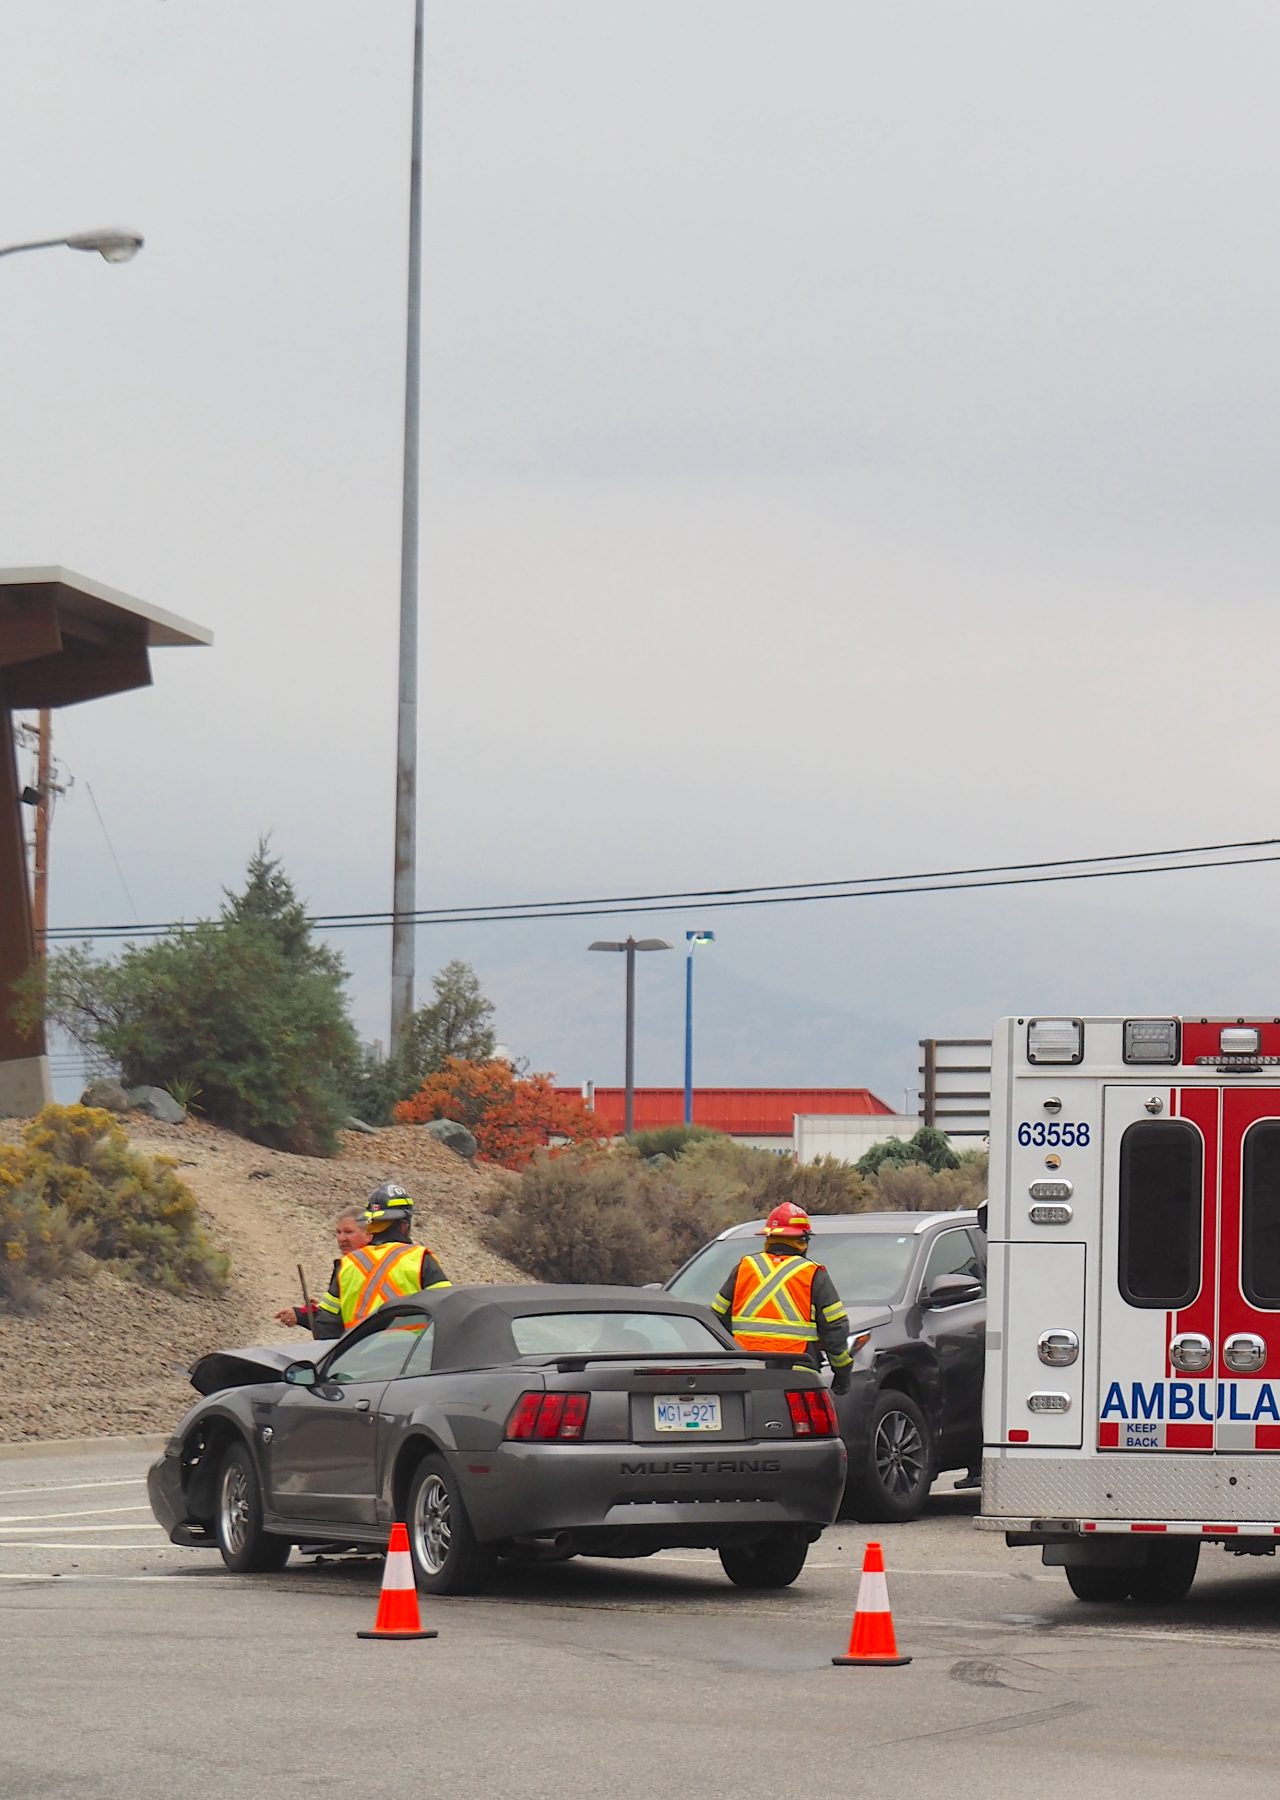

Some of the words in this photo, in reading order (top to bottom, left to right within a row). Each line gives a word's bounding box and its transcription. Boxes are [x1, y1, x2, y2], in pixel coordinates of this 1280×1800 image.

[1017, 1121, 1091, 1147] 63558
[1126, 1423, 1157, 1434] KEEP
[1126, 1436, 1159, 1448] BACK
[619, 1459, 782, 1475] MUSTANG
